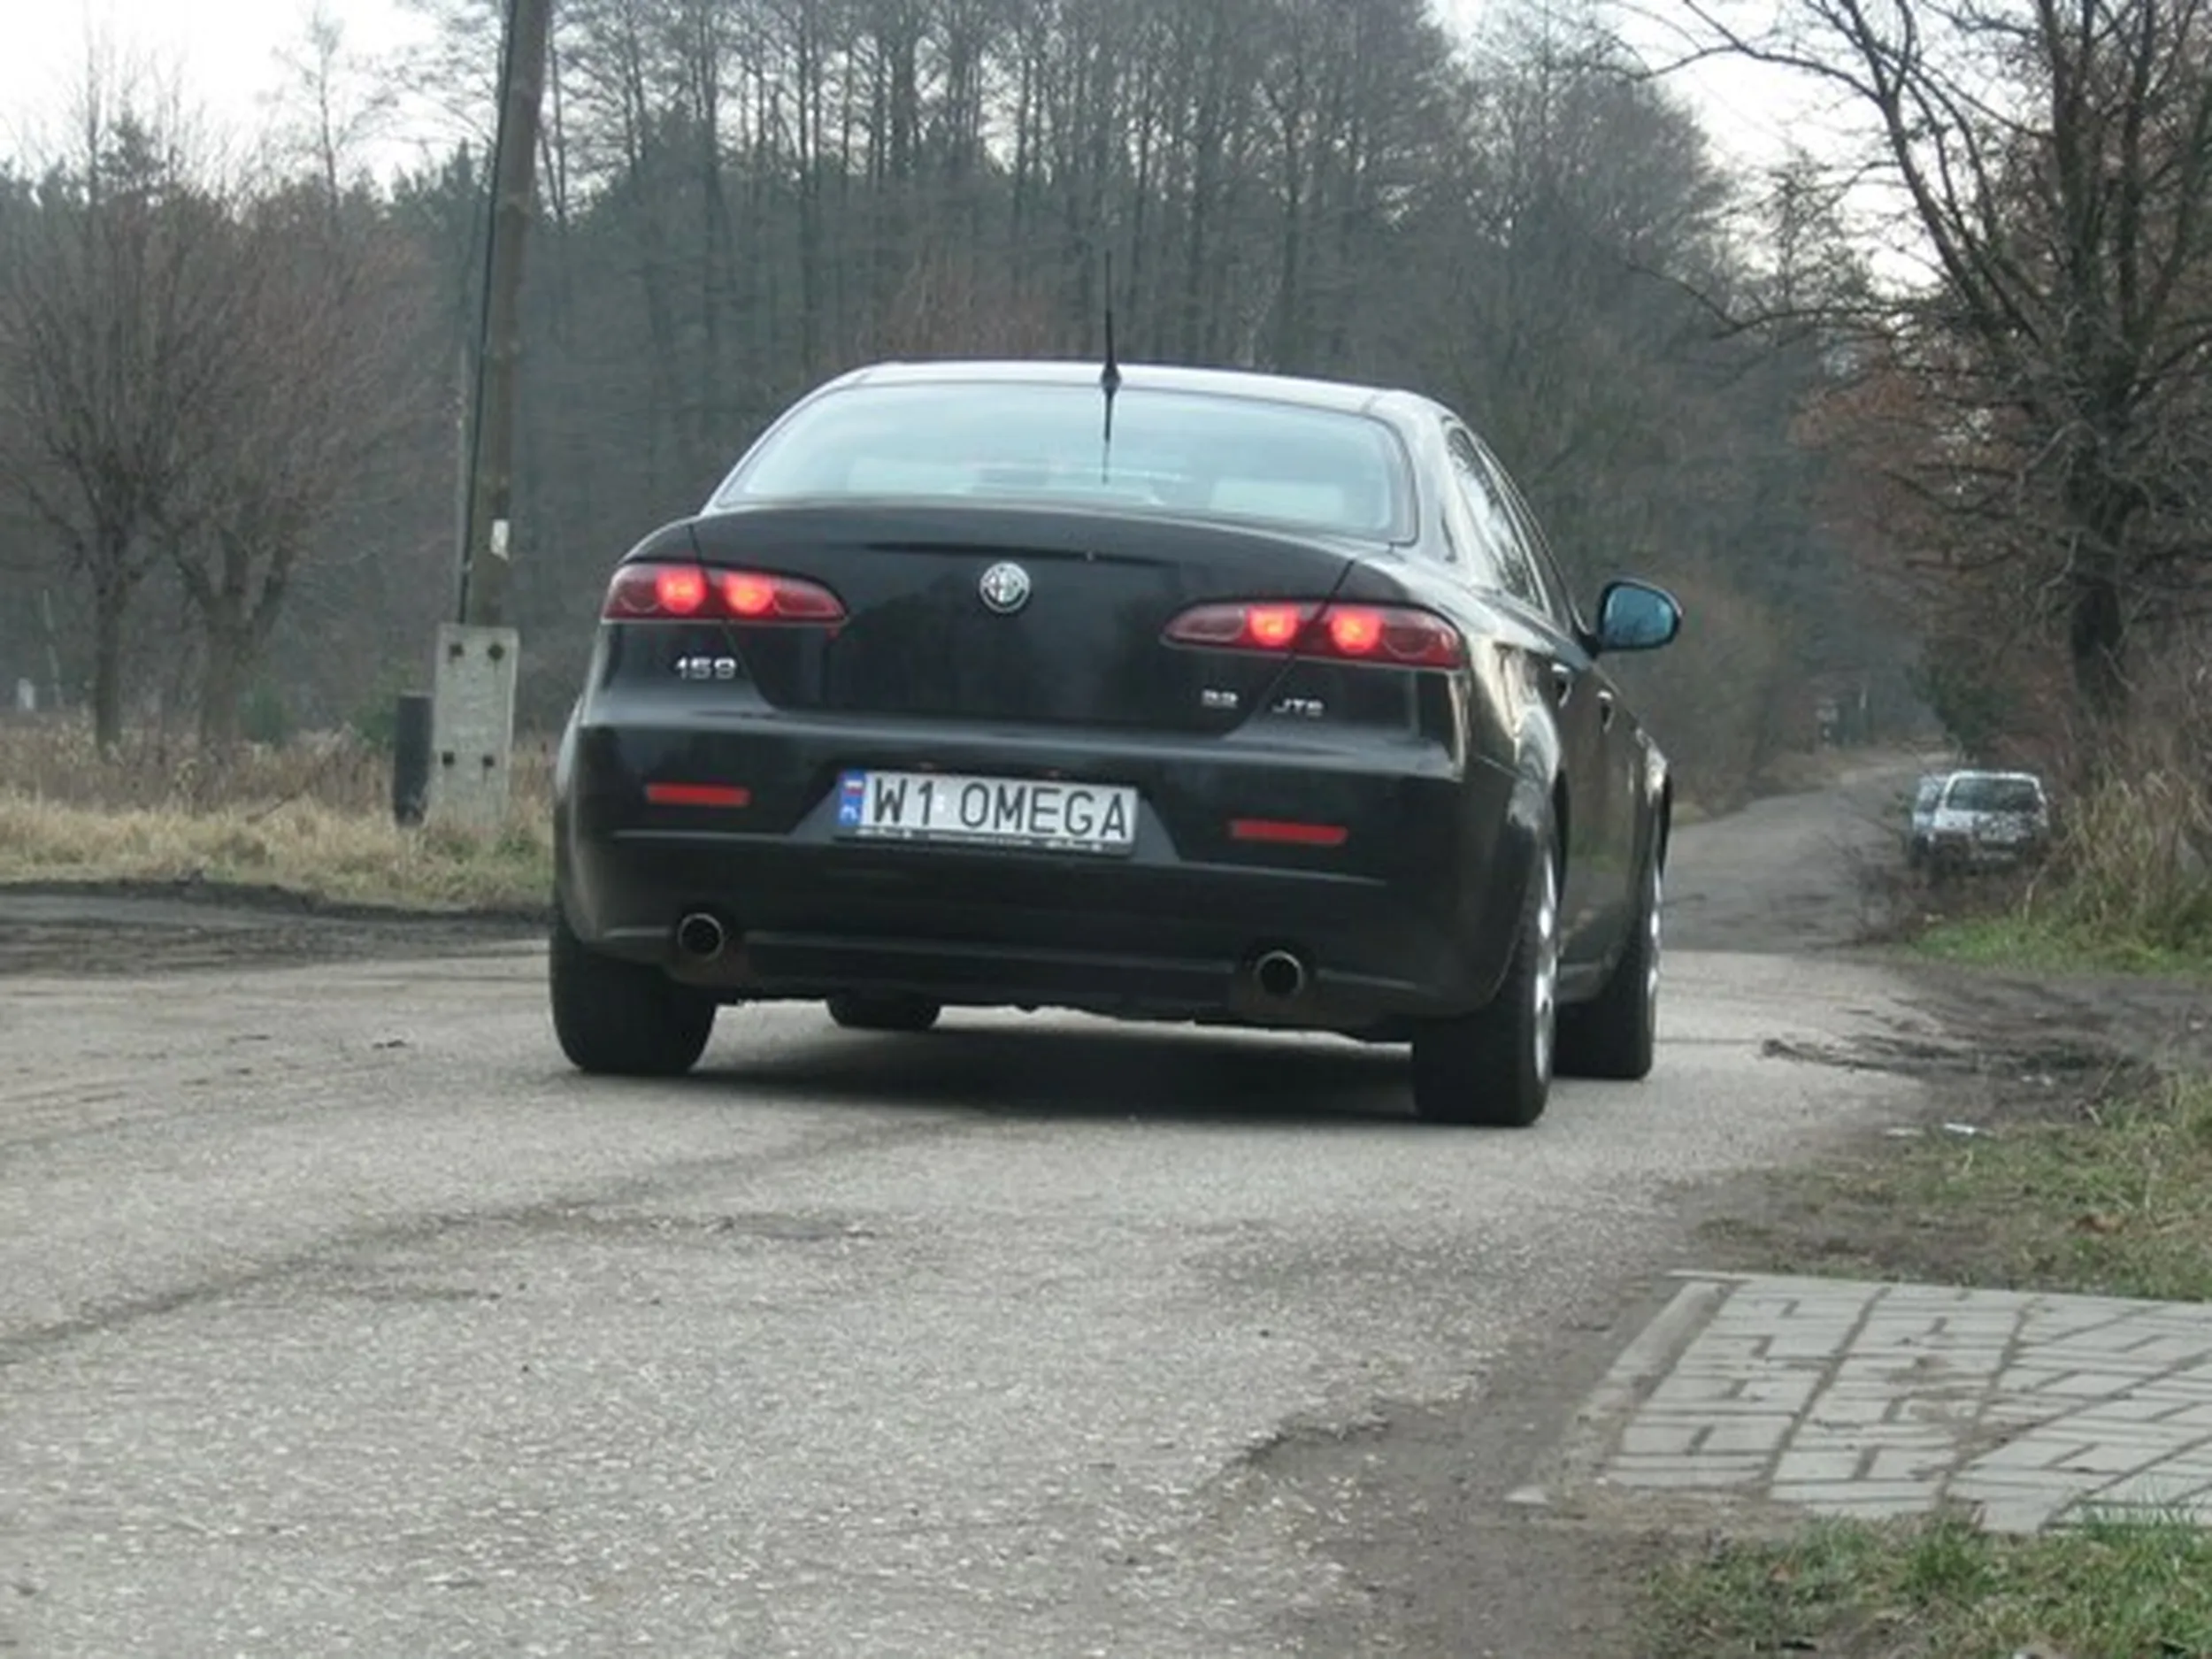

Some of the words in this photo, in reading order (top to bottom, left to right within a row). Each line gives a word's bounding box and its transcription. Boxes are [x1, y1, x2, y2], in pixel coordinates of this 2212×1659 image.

[675, 657, 736, 680] 159
[872, 777, 933, 826] W1
[960, 782, 1127, 839] OMEGA
